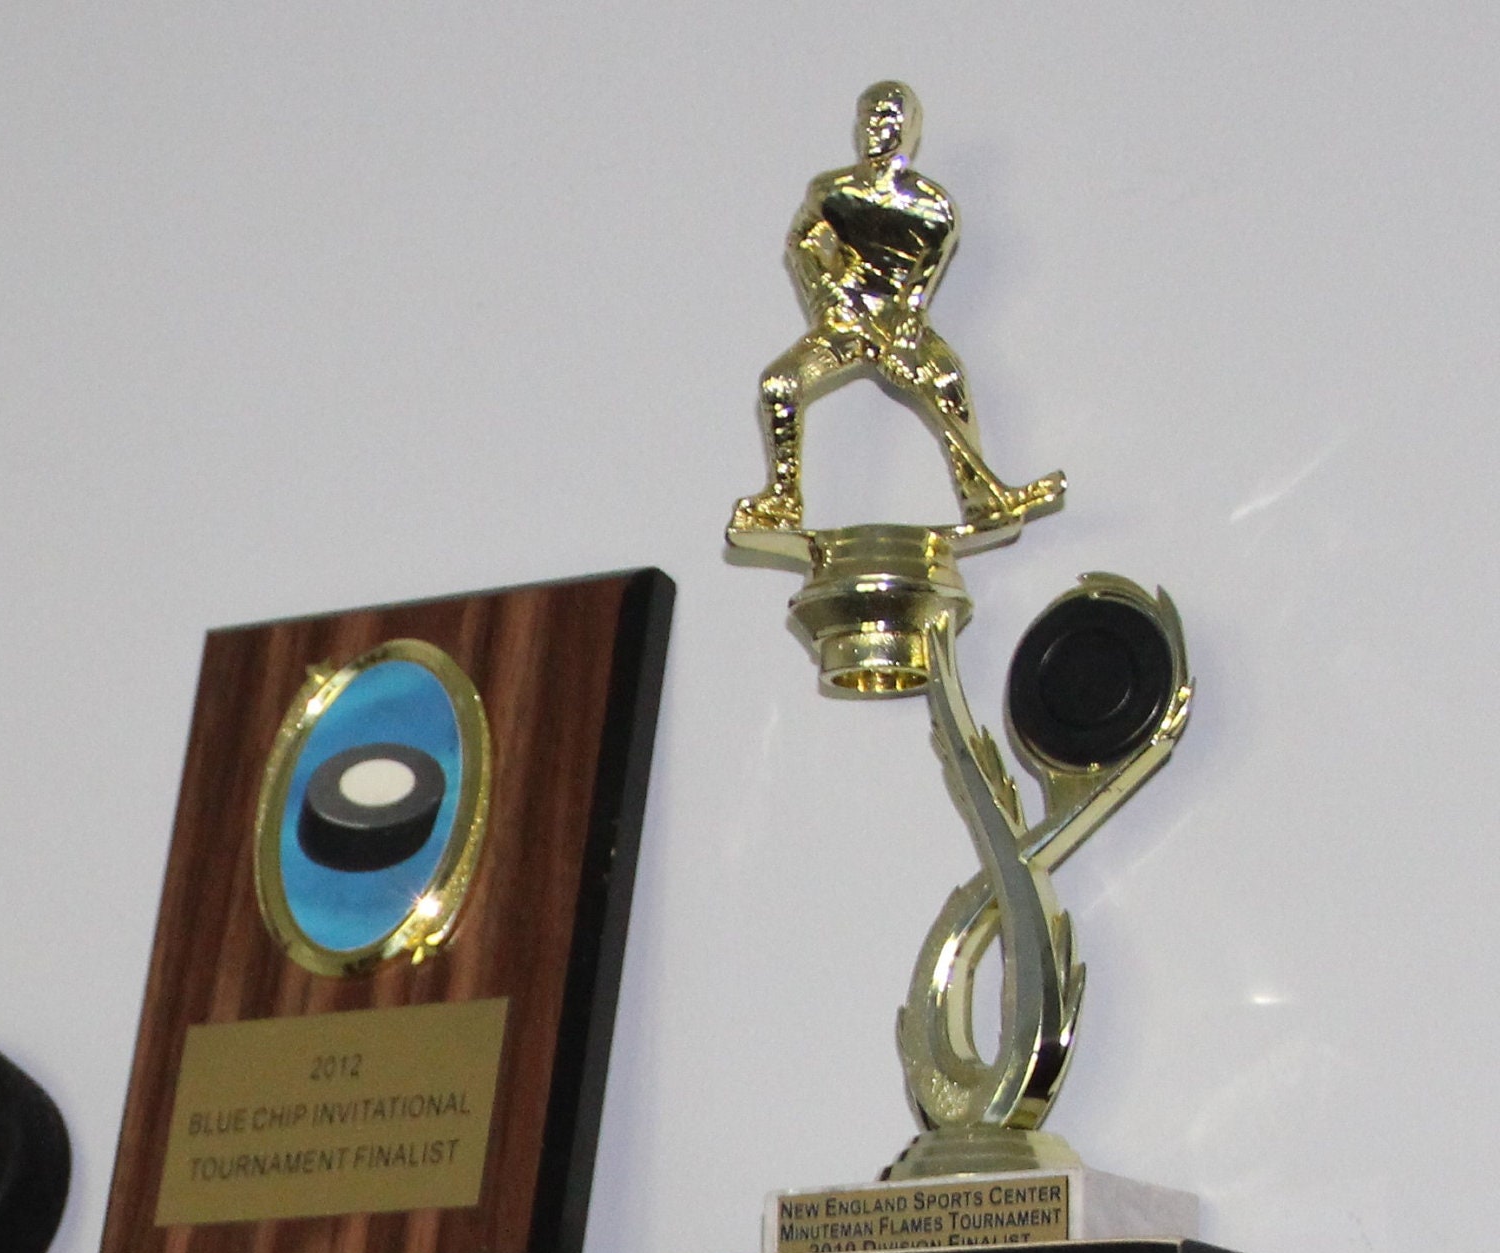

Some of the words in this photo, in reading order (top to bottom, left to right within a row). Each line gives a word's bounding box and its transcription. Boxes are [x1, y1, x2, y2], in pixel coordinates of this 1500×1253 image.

[309, 1052, 364, 1082] 2012
[188, 1108, 248, 1138] BLUE
[252, 1104, 308, 1133] CHIP
[312, 1090, 471, 1128] INVITATIONAL
[190, 1147, 349, 1182] TOURNAMENT
[353, 1138, 460, 1172] FINALIST
[780, 1200, 820, 1220] NEW
[825, 1196, 908, 1218] ENGLAND
[913, 1190, 983, 1211] SPORTS
[989, 1185, 1061, 1205] CENTER
[780, 1221, 874, 1242] MINUTEMAN
[879, 1215, 944, 1237] FLAMES
[948, 1207, 1062, 1231] TOURNAMENT
